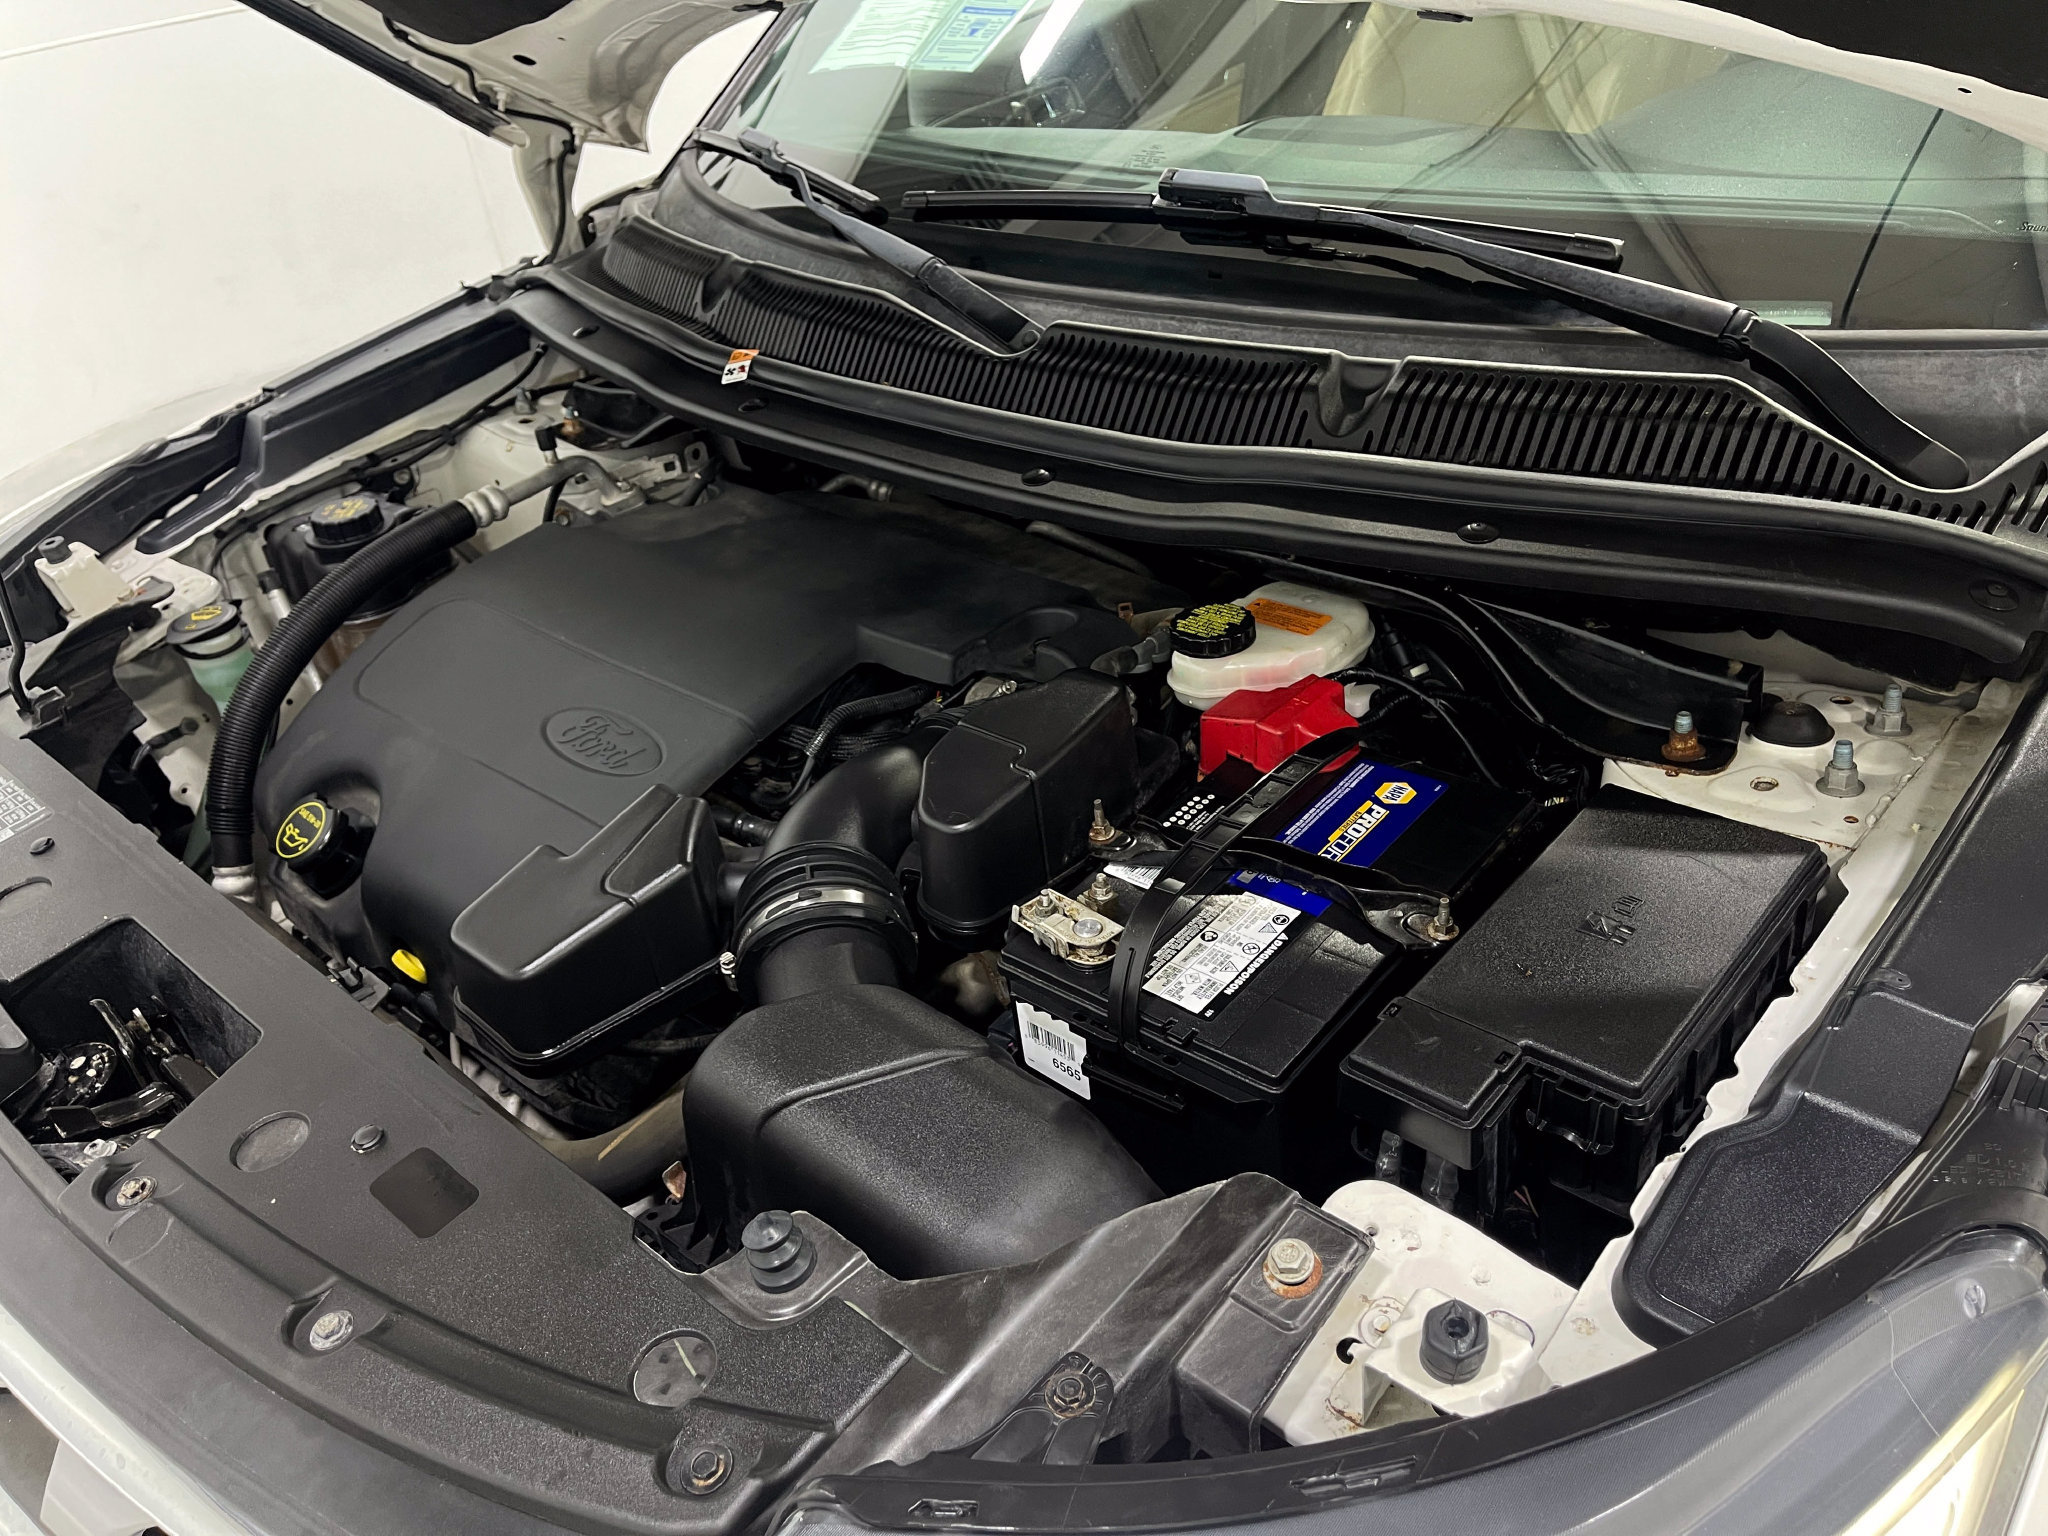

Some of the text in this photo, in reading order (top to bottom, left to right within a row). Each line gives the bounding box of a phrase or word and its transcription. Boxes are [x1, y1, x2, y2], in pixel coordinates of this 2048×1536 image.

[2020, 221, 2048, 231] Soun
[557, 715, 647, 769] Ford
[1383, 784, 1409, 801] NAPA
[1320, 803, 1387, 861] PROFOR
[1052, 1058, 1081, 1080] 6565
